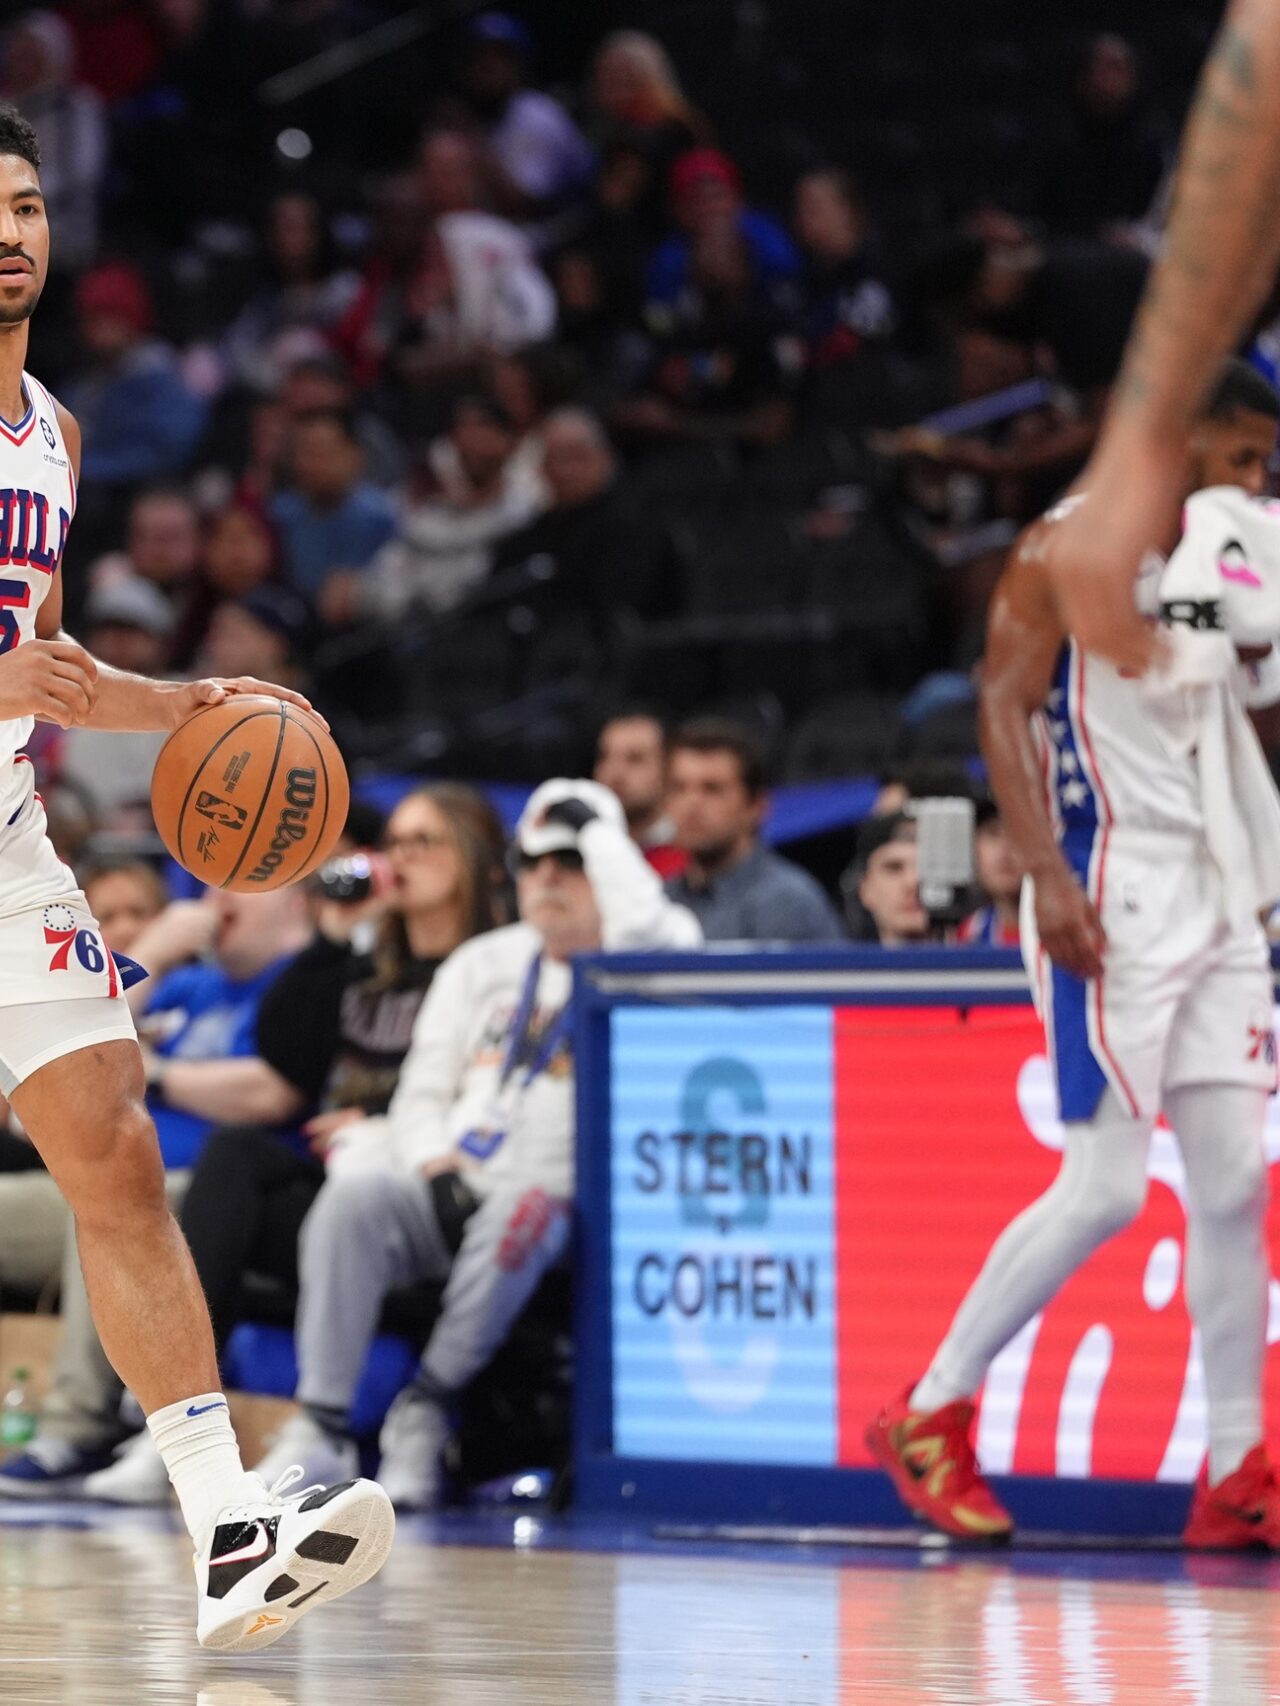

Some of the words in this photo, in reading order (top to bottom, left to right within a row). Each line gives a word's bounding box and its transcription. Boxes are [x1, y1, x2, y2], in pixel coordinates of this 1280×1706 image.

[245, 767, 318, 882] Wilson
[43, 926, 105, 974] 76
[633, 1131, 812, 1194] STERN
[634, 1254, 816, 1318] COHEN
